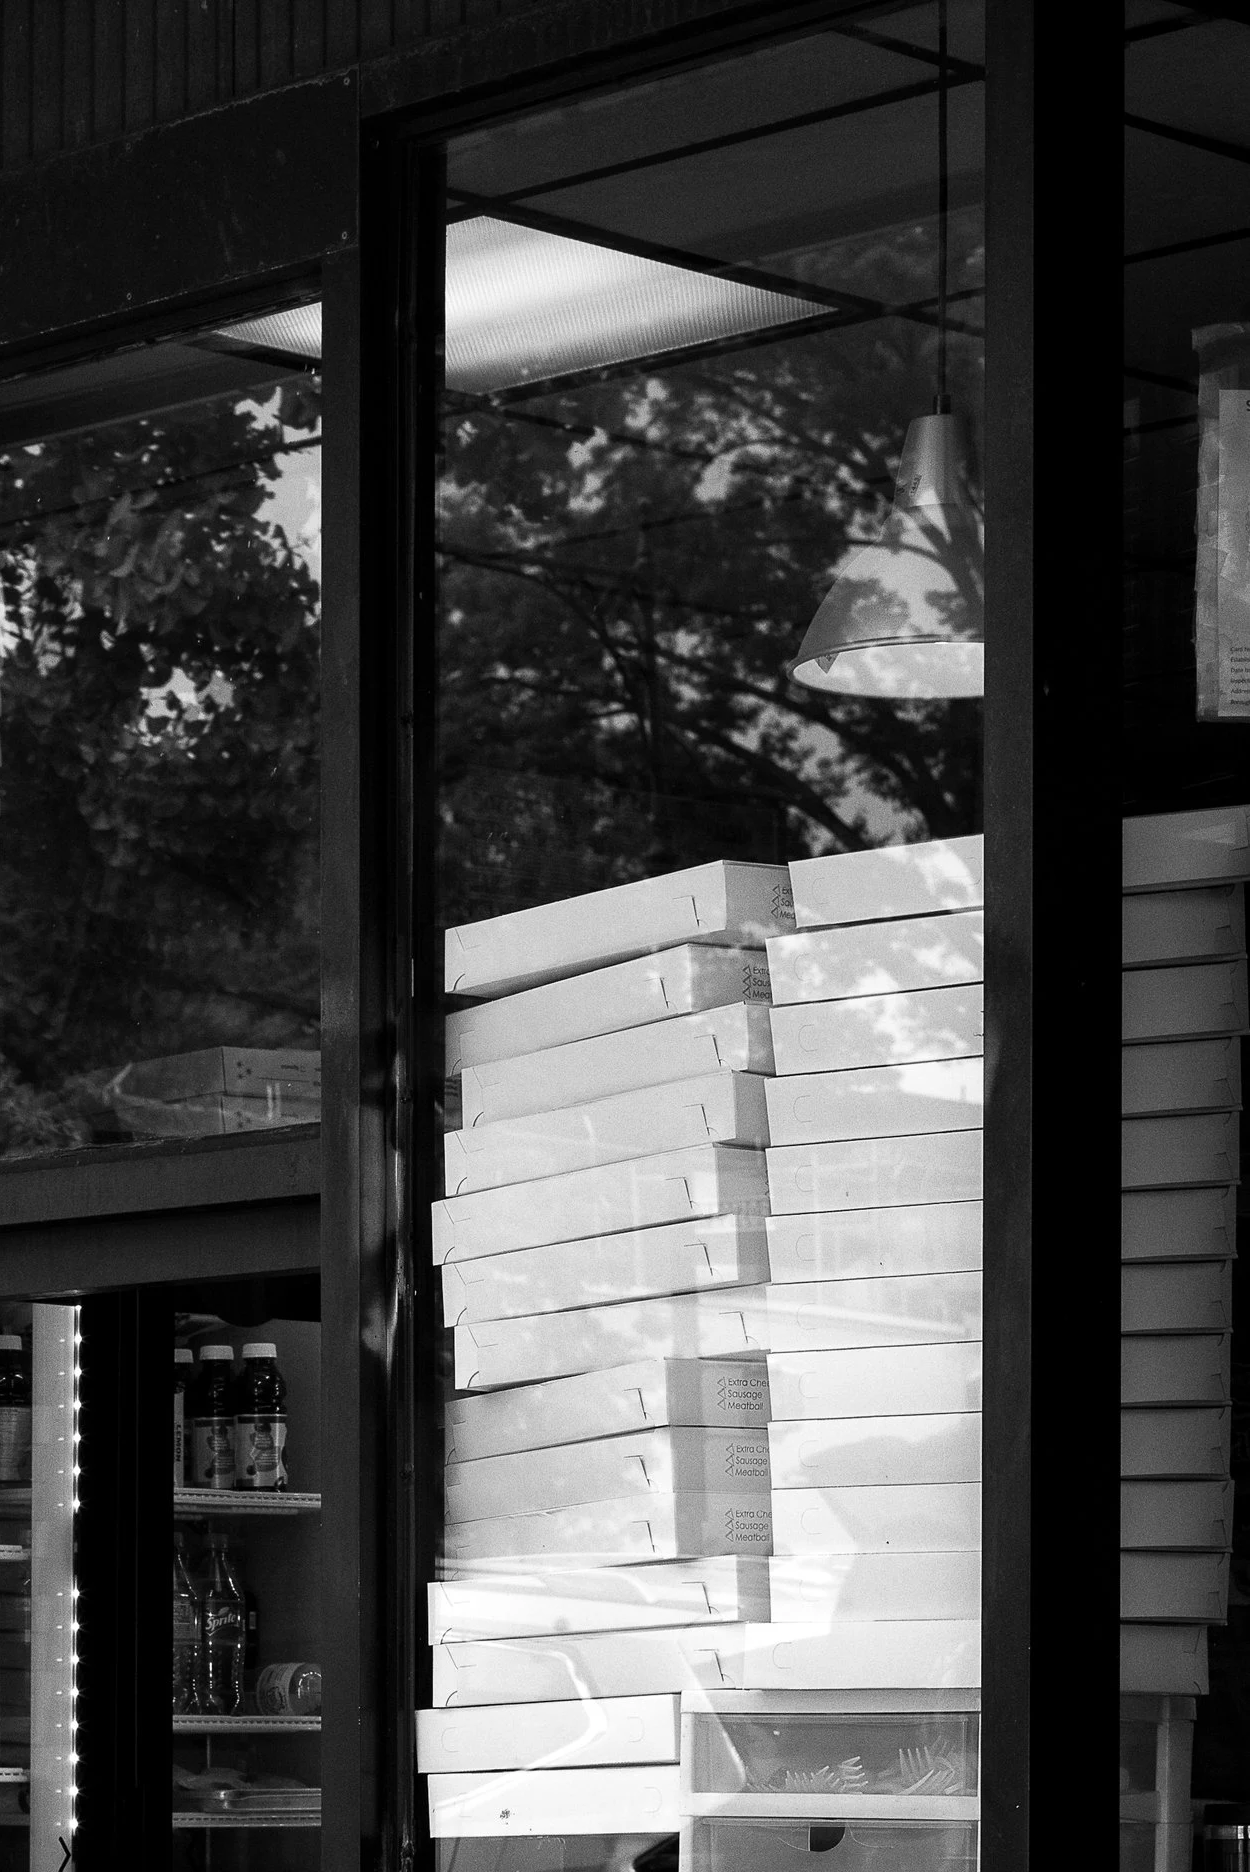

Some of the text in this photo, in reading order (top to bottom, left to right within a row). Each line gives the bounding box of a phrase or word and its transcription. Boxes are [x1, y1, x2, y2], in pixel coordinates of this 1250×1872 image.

[728, 1378, 748, 1387] Extra
[727, 1389, 763, 1399] Sausage
[727, 1401, 764, 1410] Meatball
[736, 1445, 755, 1454] Extra
[735, 1455, 768, 1466] Sausage
[735, 1509, 754, 1518] Extra
[735, 1520, 769, 1531] Sausage
[205, 1613, 236, 1631] Sprite
